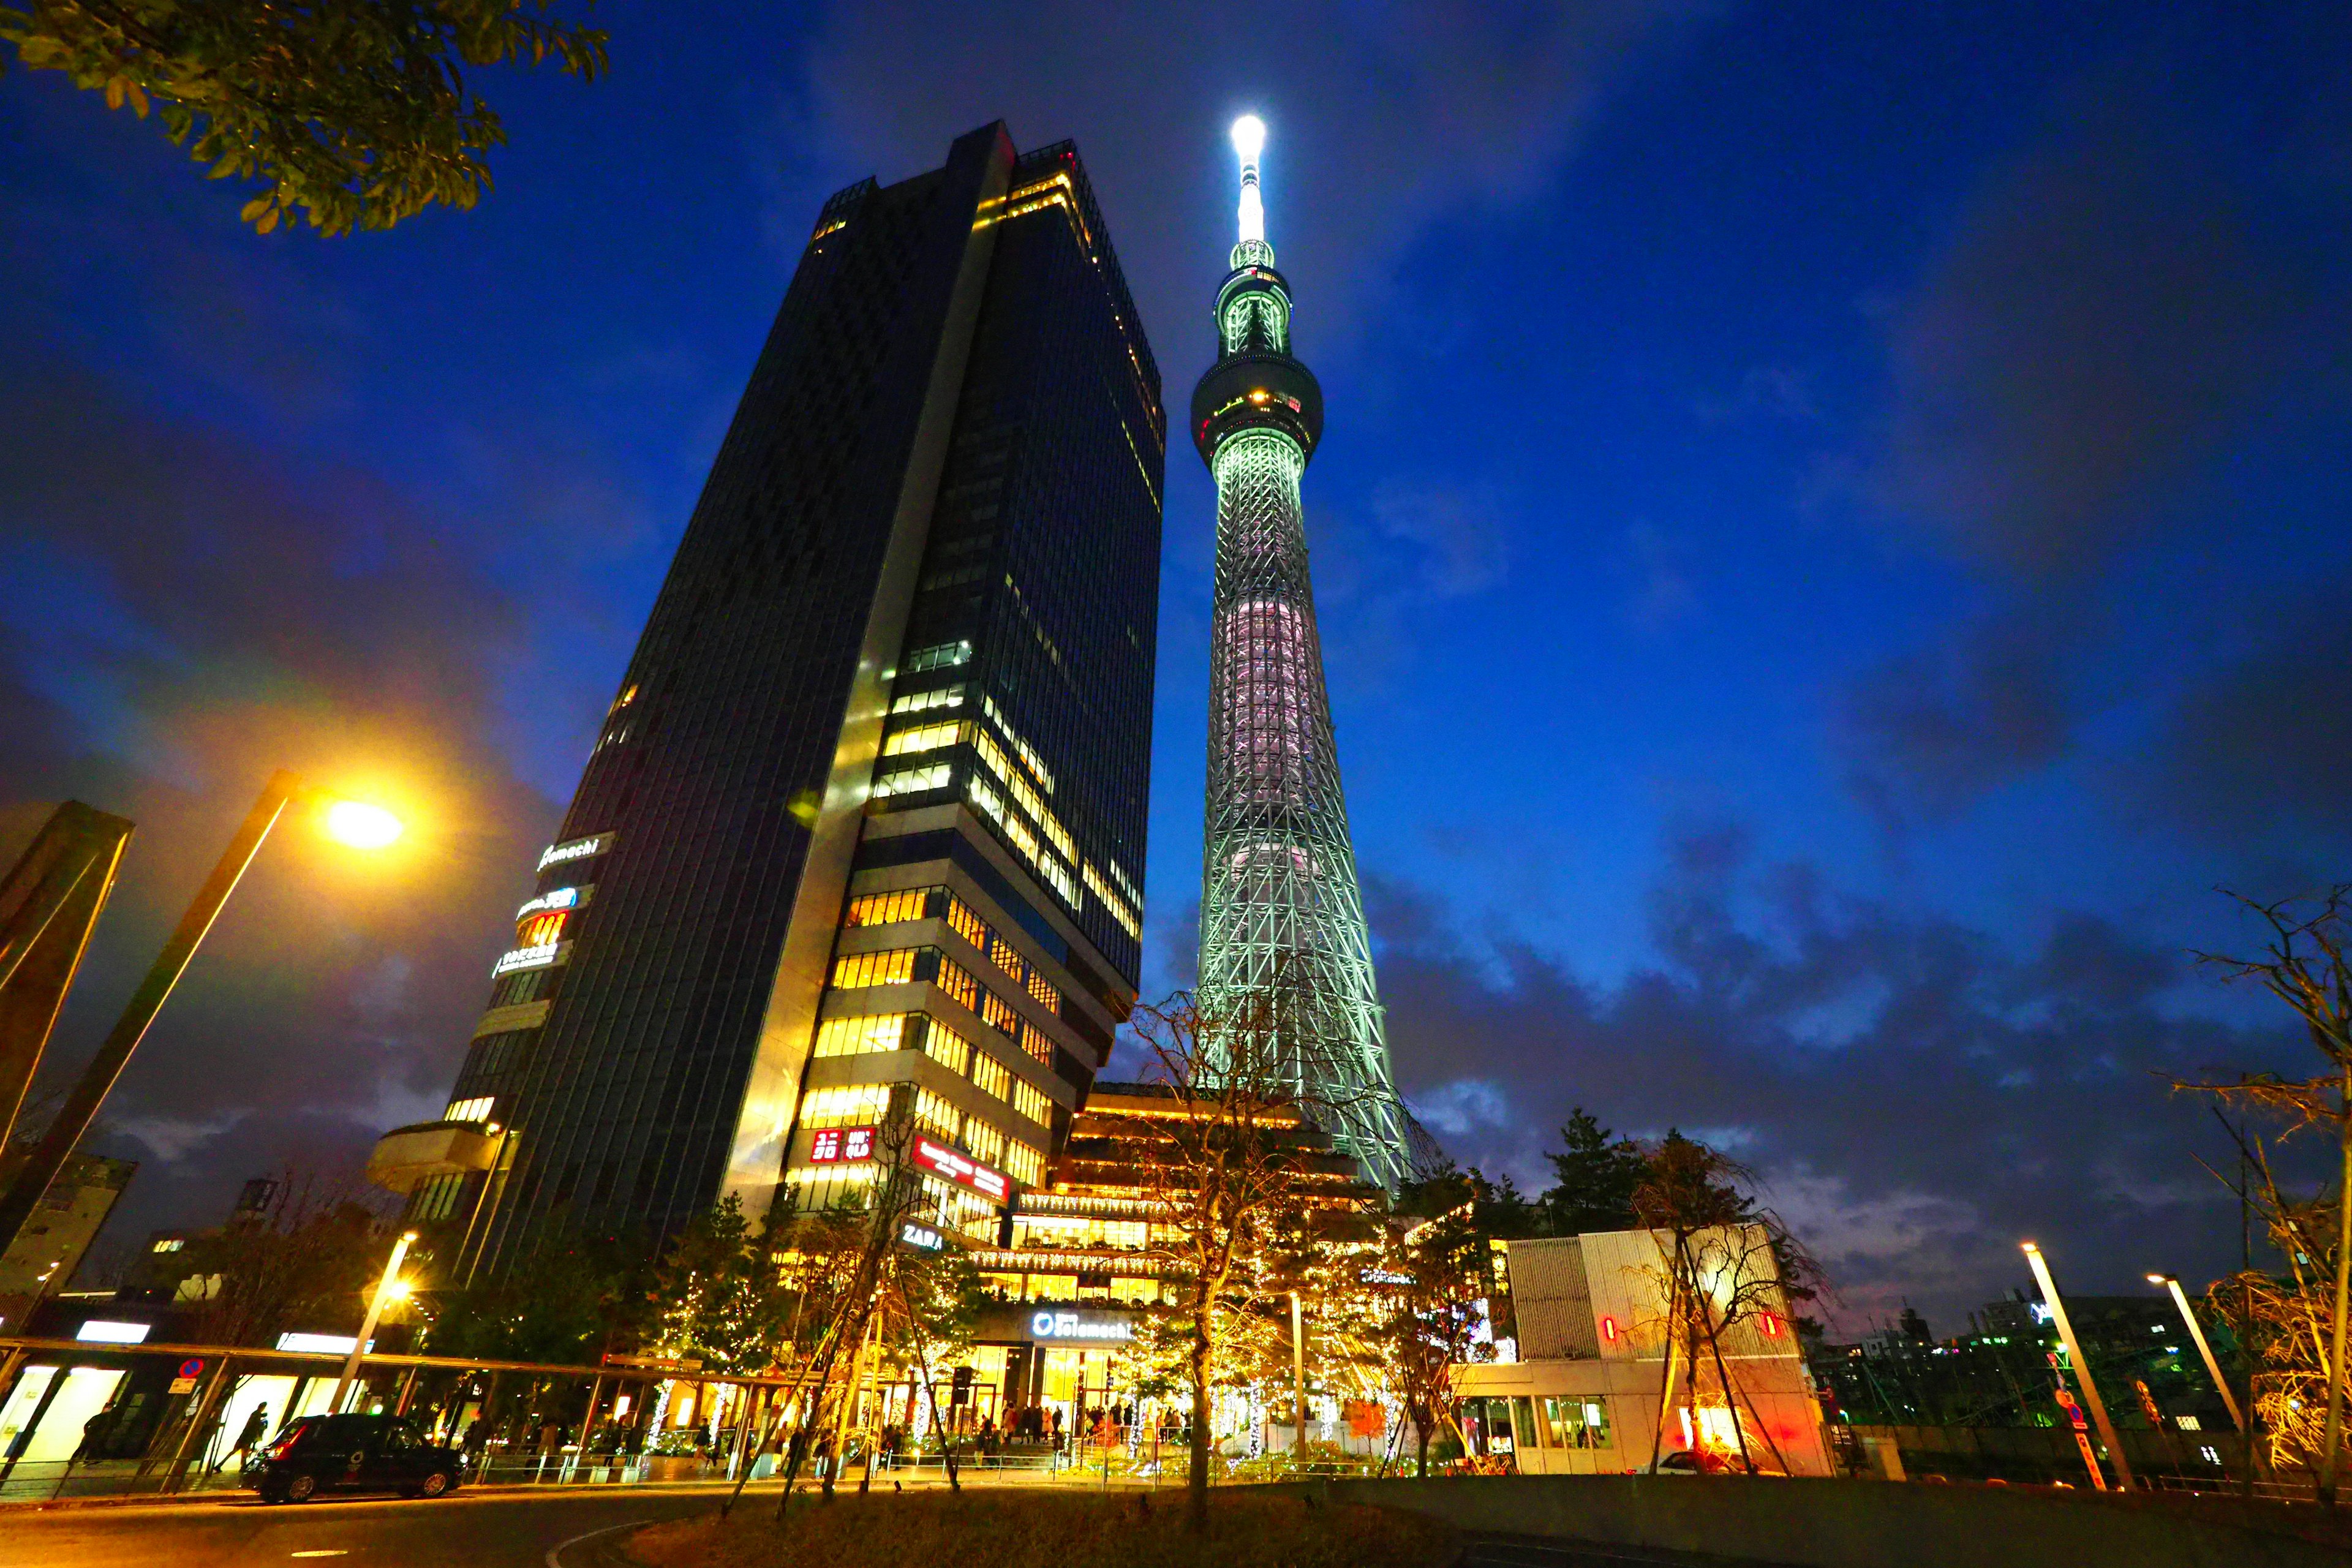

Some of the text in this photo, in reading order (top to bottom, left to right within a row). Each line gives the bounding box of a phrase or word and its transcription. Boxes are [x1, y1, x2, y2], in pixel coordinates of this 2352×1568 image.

[846, 1144, 869, 1159] QLO
[903, 1224, 943, 1250] ZARA
[1054, 1321, 1133, 1339] Solamachi
